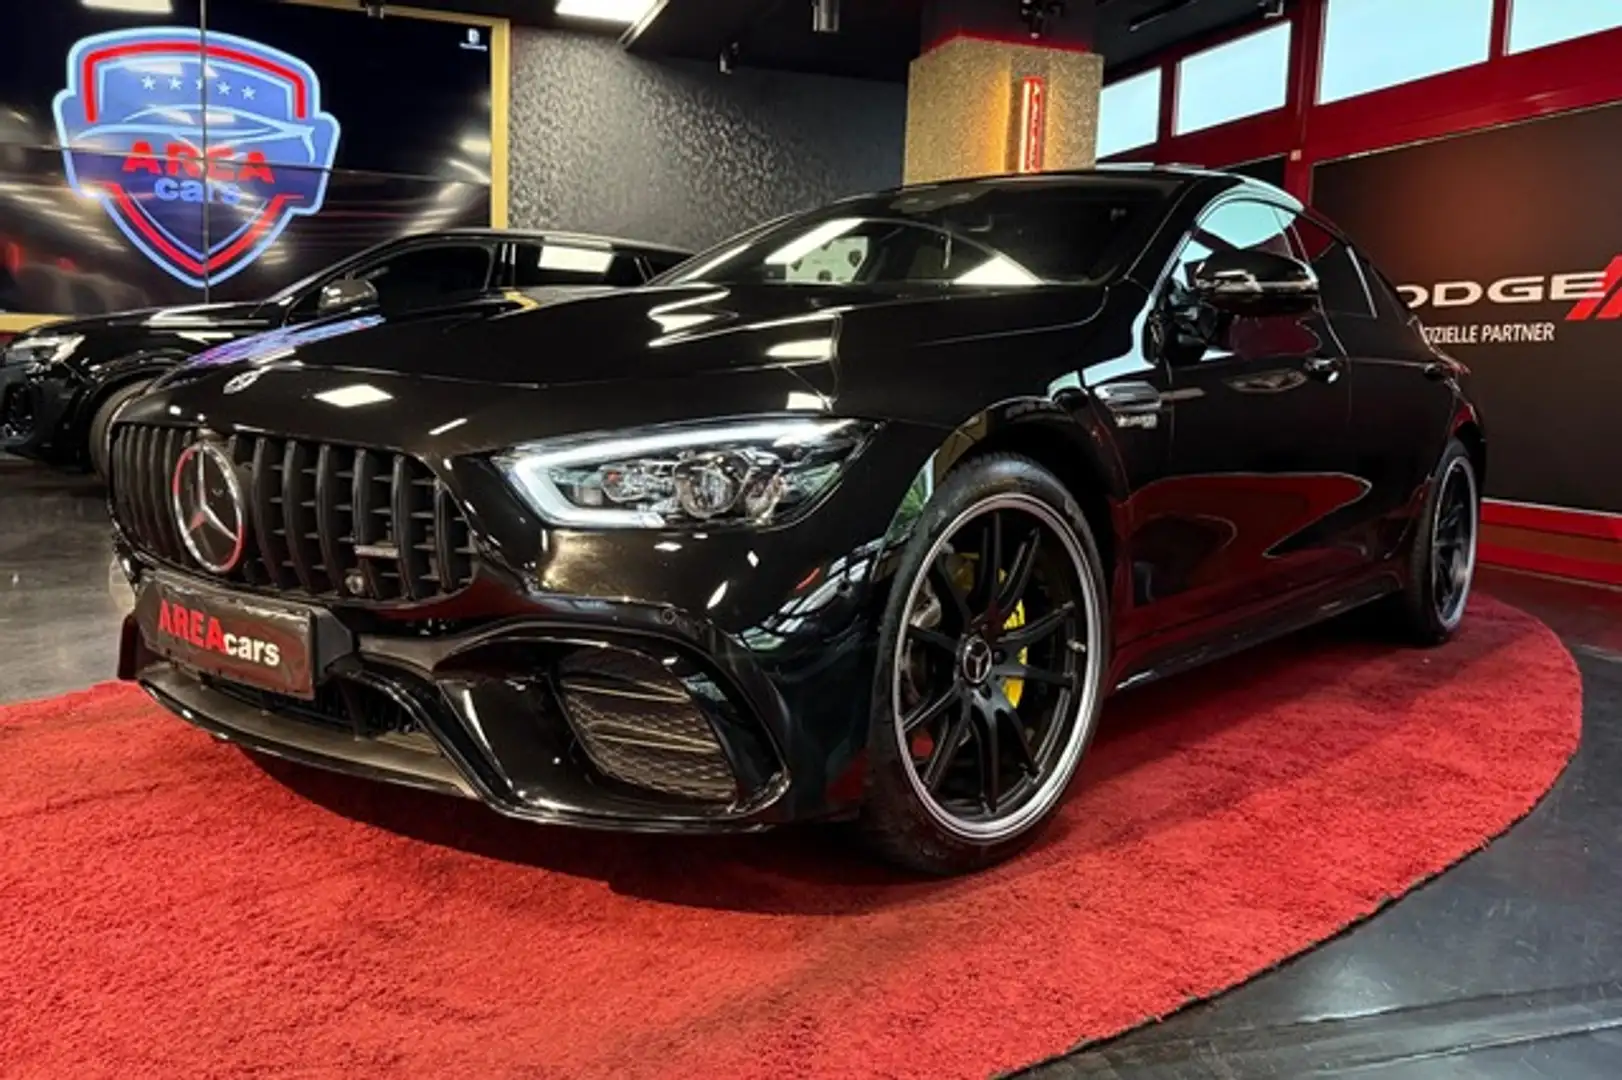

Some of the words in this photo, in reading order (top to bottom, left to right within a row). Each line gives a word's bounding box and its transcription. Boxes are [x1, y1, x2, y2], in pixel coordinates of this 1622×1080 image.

[122, 140, 275, 184] AREA
[154, 177, 241, 205] cars
[1481, 322, 1555, 343] PARTNER
